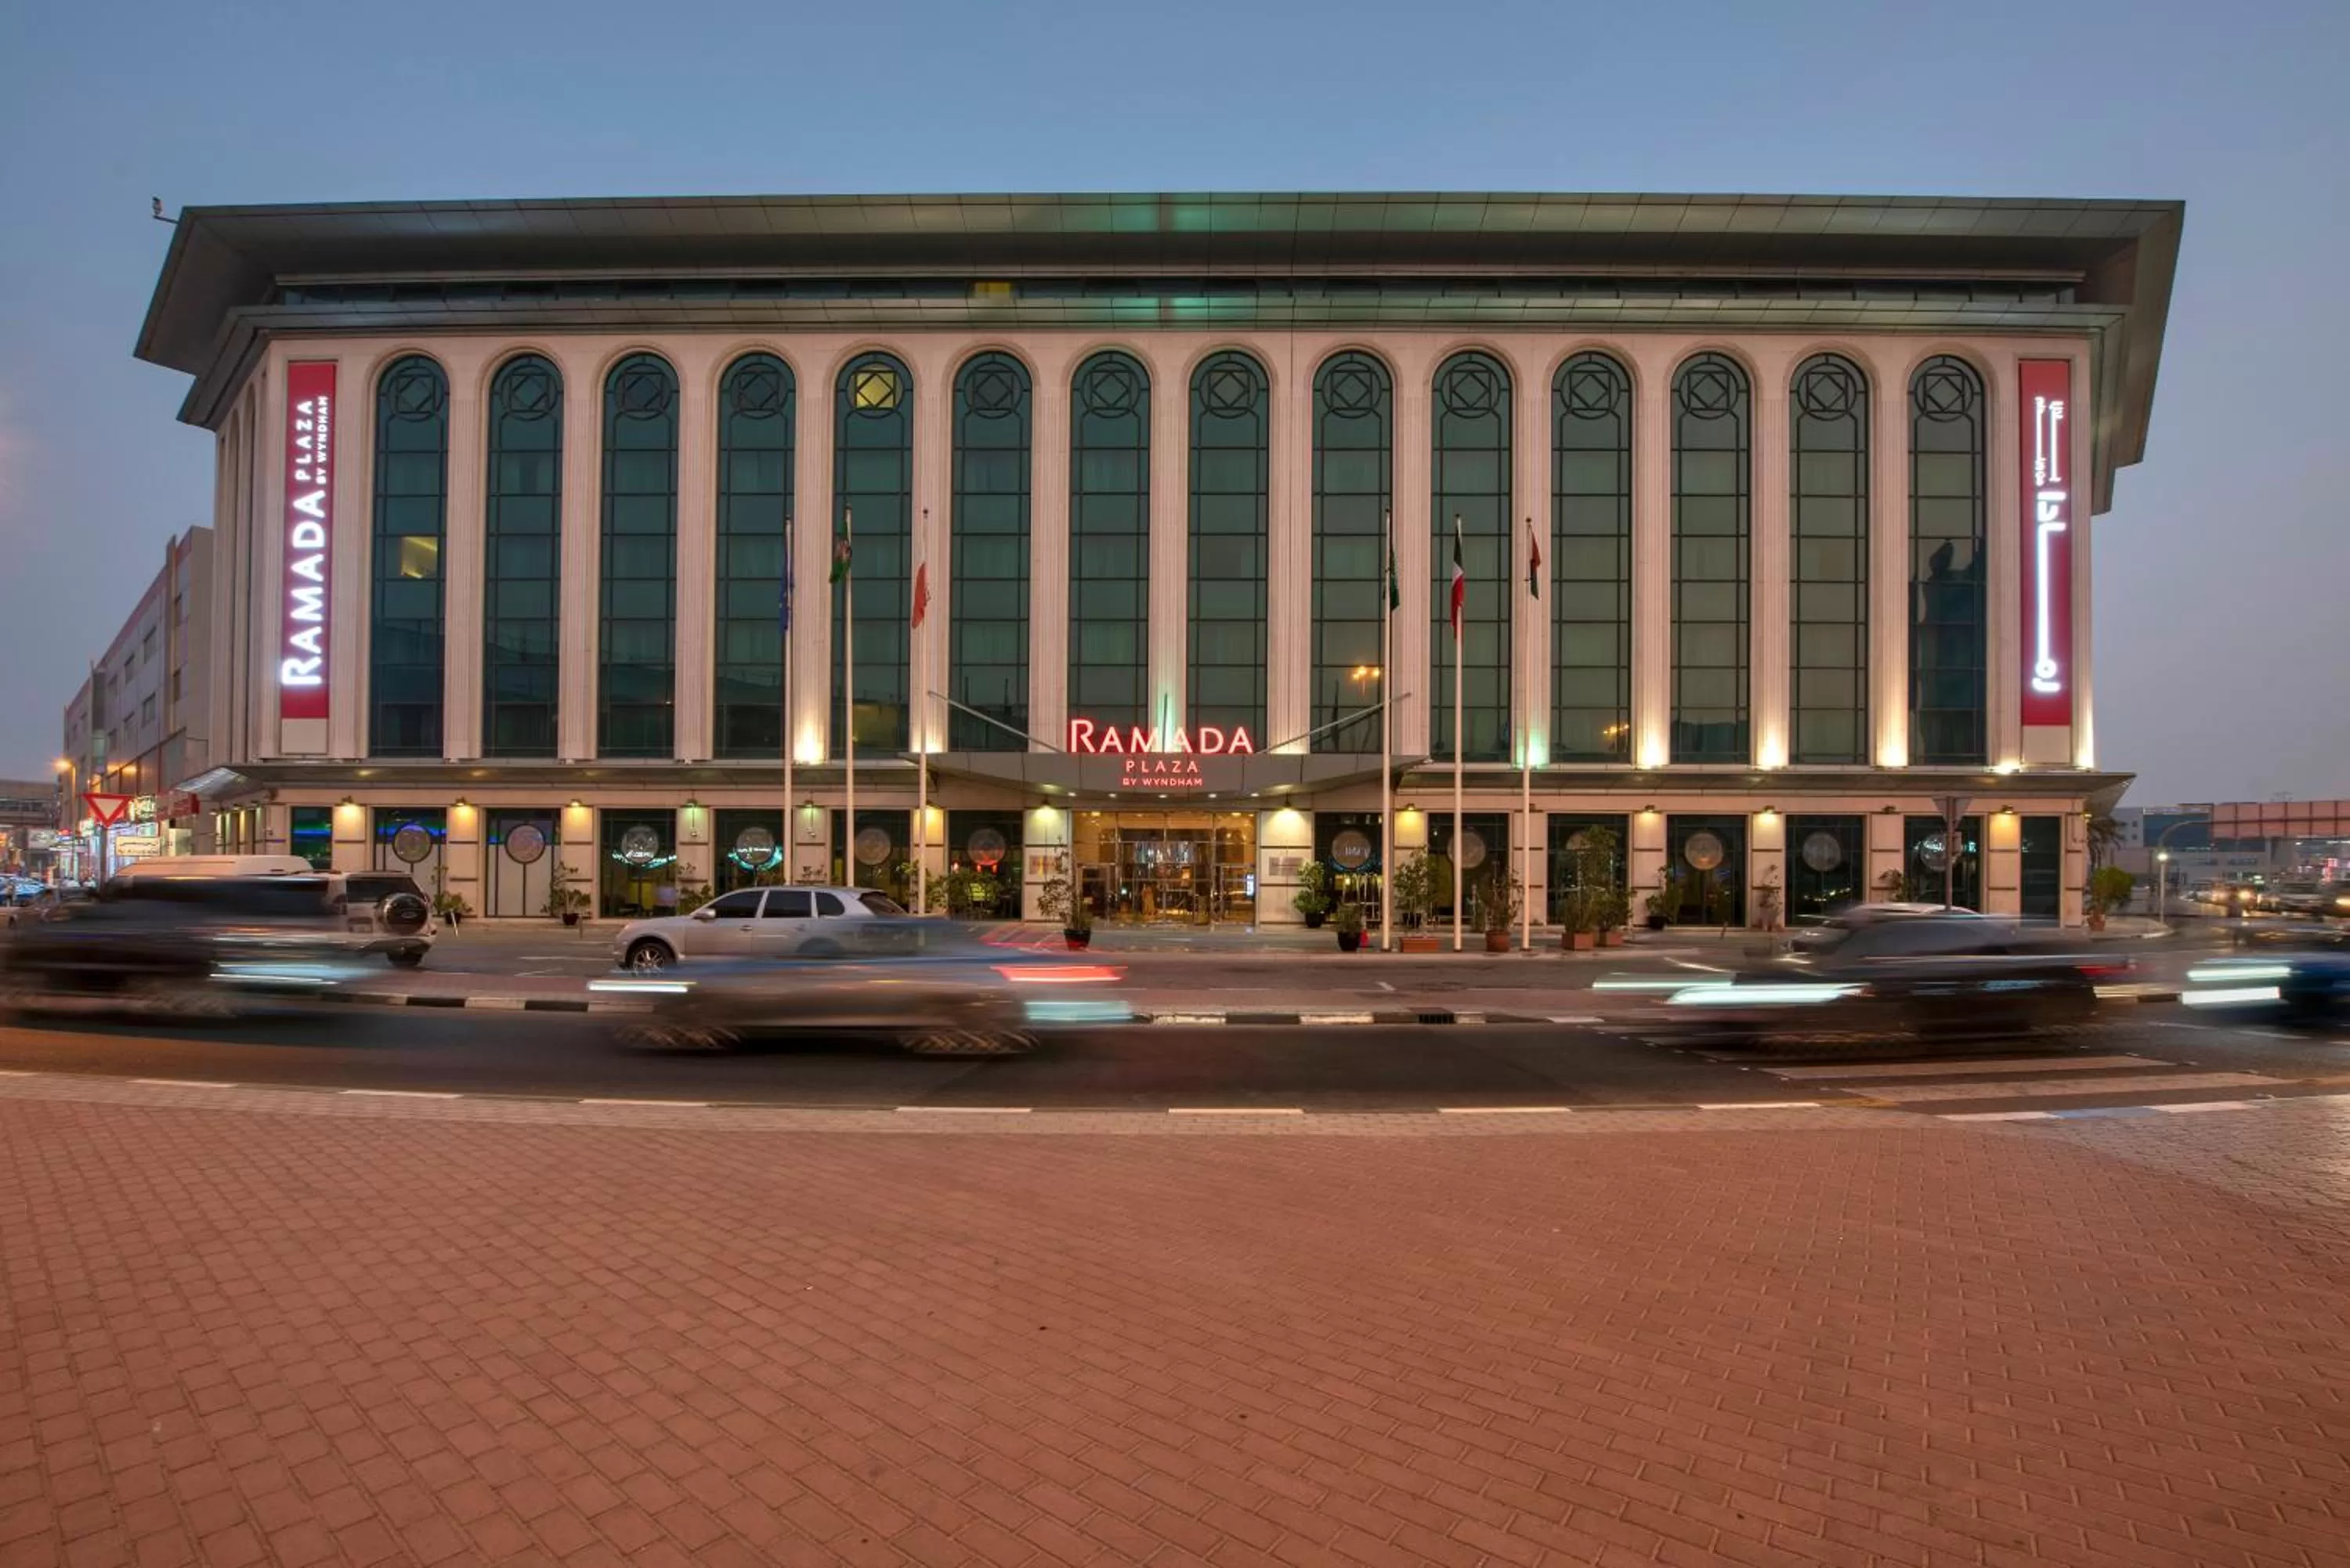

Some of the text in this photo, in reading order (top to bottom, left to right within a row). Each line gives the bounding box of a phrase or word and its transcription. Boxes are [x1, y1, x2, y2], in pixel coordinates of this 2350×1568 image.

[295, 400, 313, 481] PLAZA
[316, 396, 329, 485] BY WYNDHAM
[281, 490, 327, 687] RAMADA
[1070, 718, 1255, 753] RAMADA
[1123, 778, 1203, 786] BY WYNDHAM
[1125, 761, 1198, 773] PLAZA
